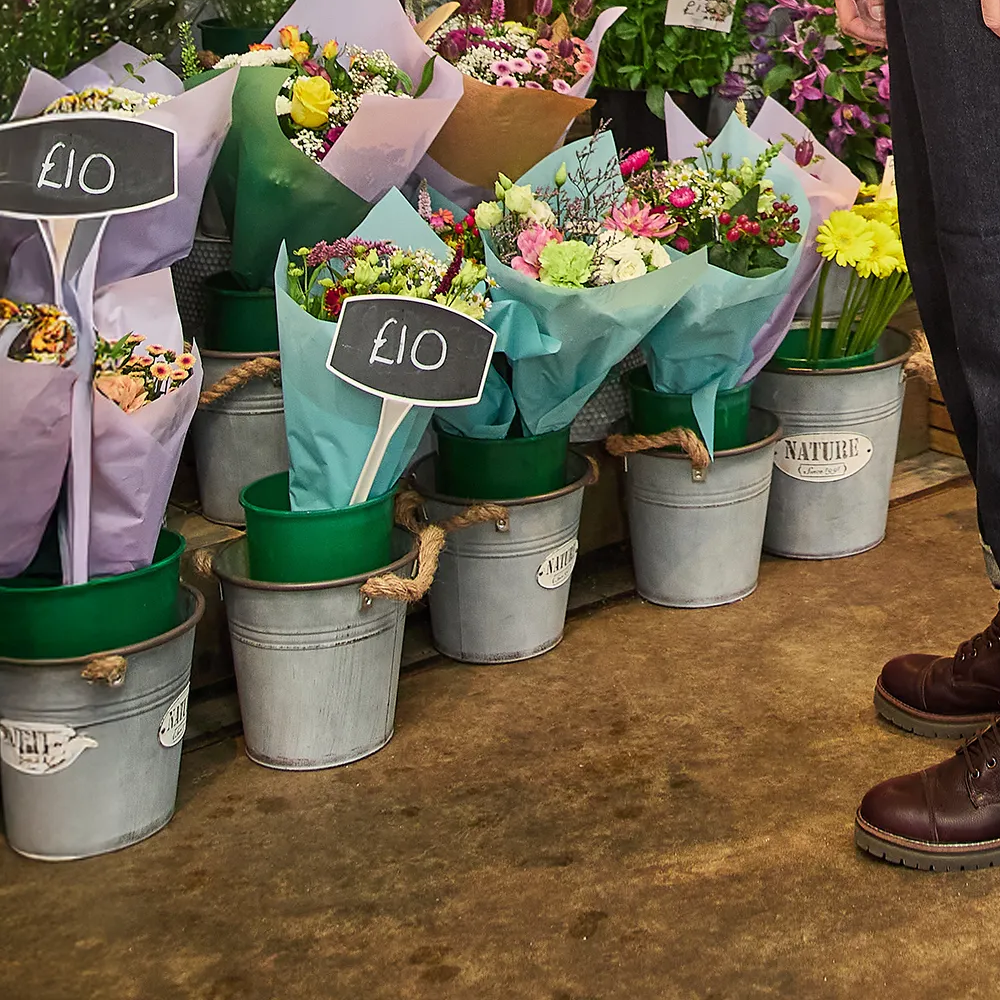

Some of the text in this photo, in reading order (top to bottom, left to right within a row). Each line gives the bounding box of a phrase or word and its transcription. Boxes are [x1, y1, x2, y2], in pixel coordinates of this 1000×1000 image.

[37, 141, 116, 195] £10
[368, 317, 448, 371] £10
[784, 438, 859, 461] NATURE
